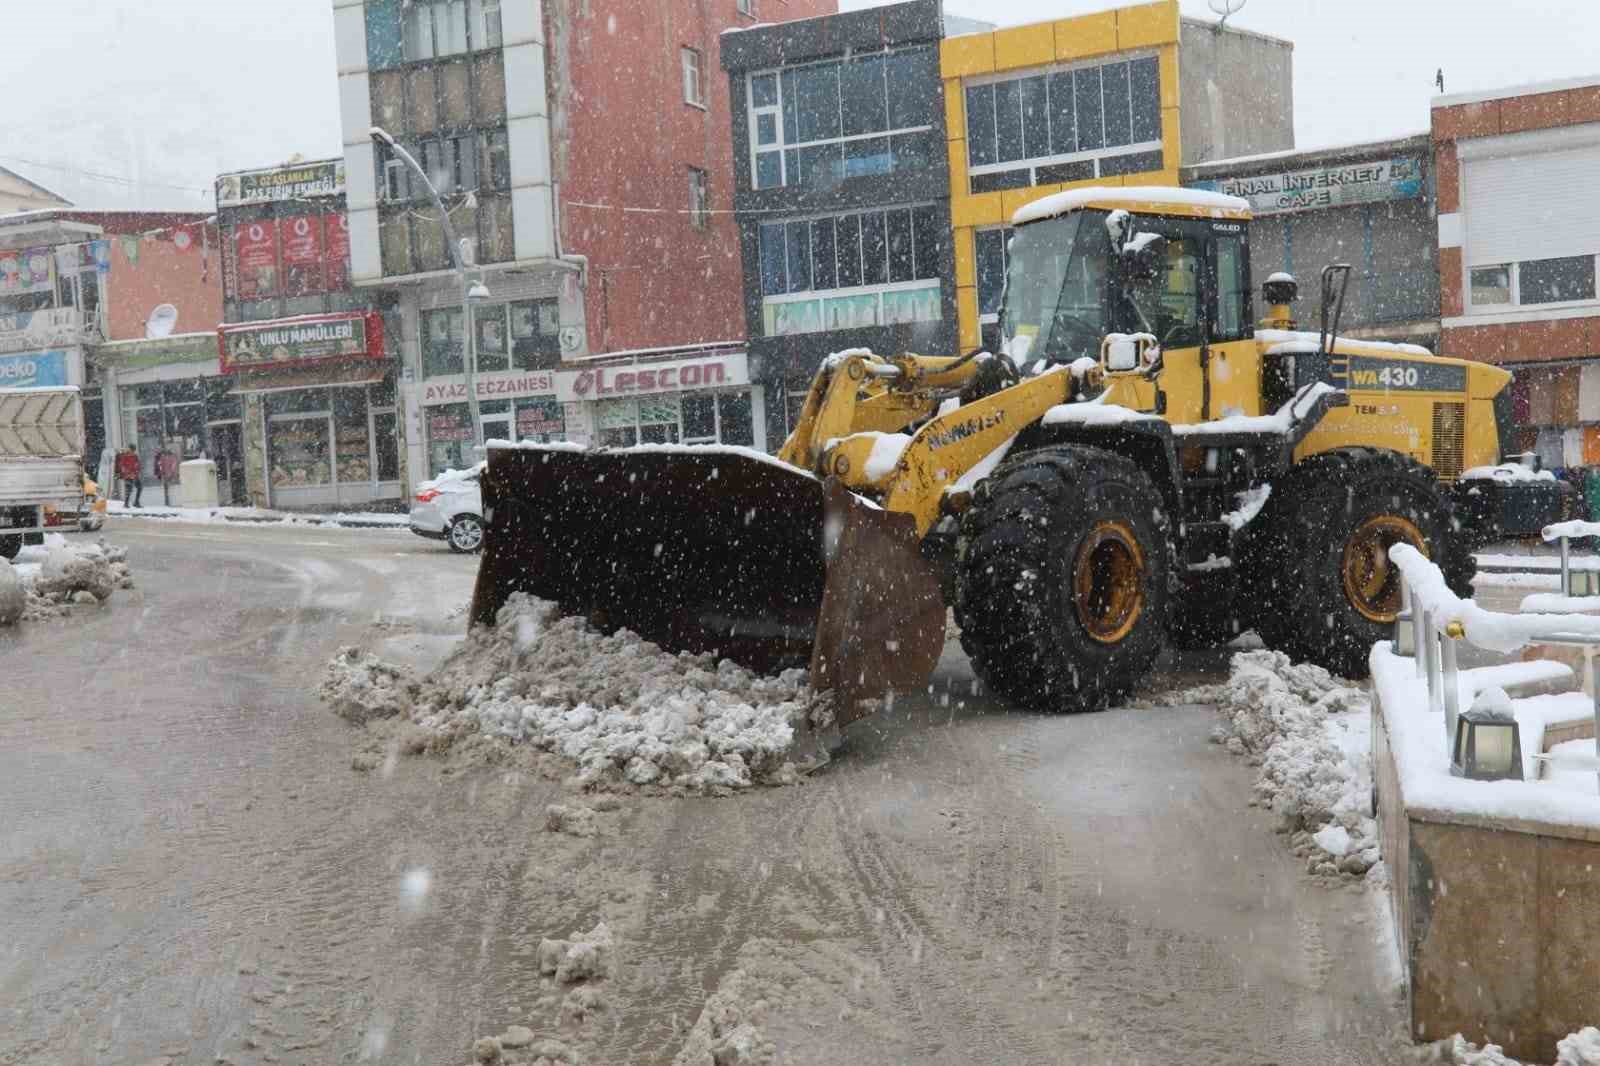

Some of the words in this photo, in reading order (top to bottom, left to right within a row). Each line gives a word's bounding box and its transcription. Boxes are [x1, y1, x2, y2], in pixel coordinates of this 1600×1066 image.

[260, 330, 289, 346] UNLU
[291, 320, 353, 344] MAMÜLLERİ
[426, 383, 467, 400] AYAZ
[476, 372, 553, 395] ECZANESİ
[596, 362, 725, 394] Lescon
